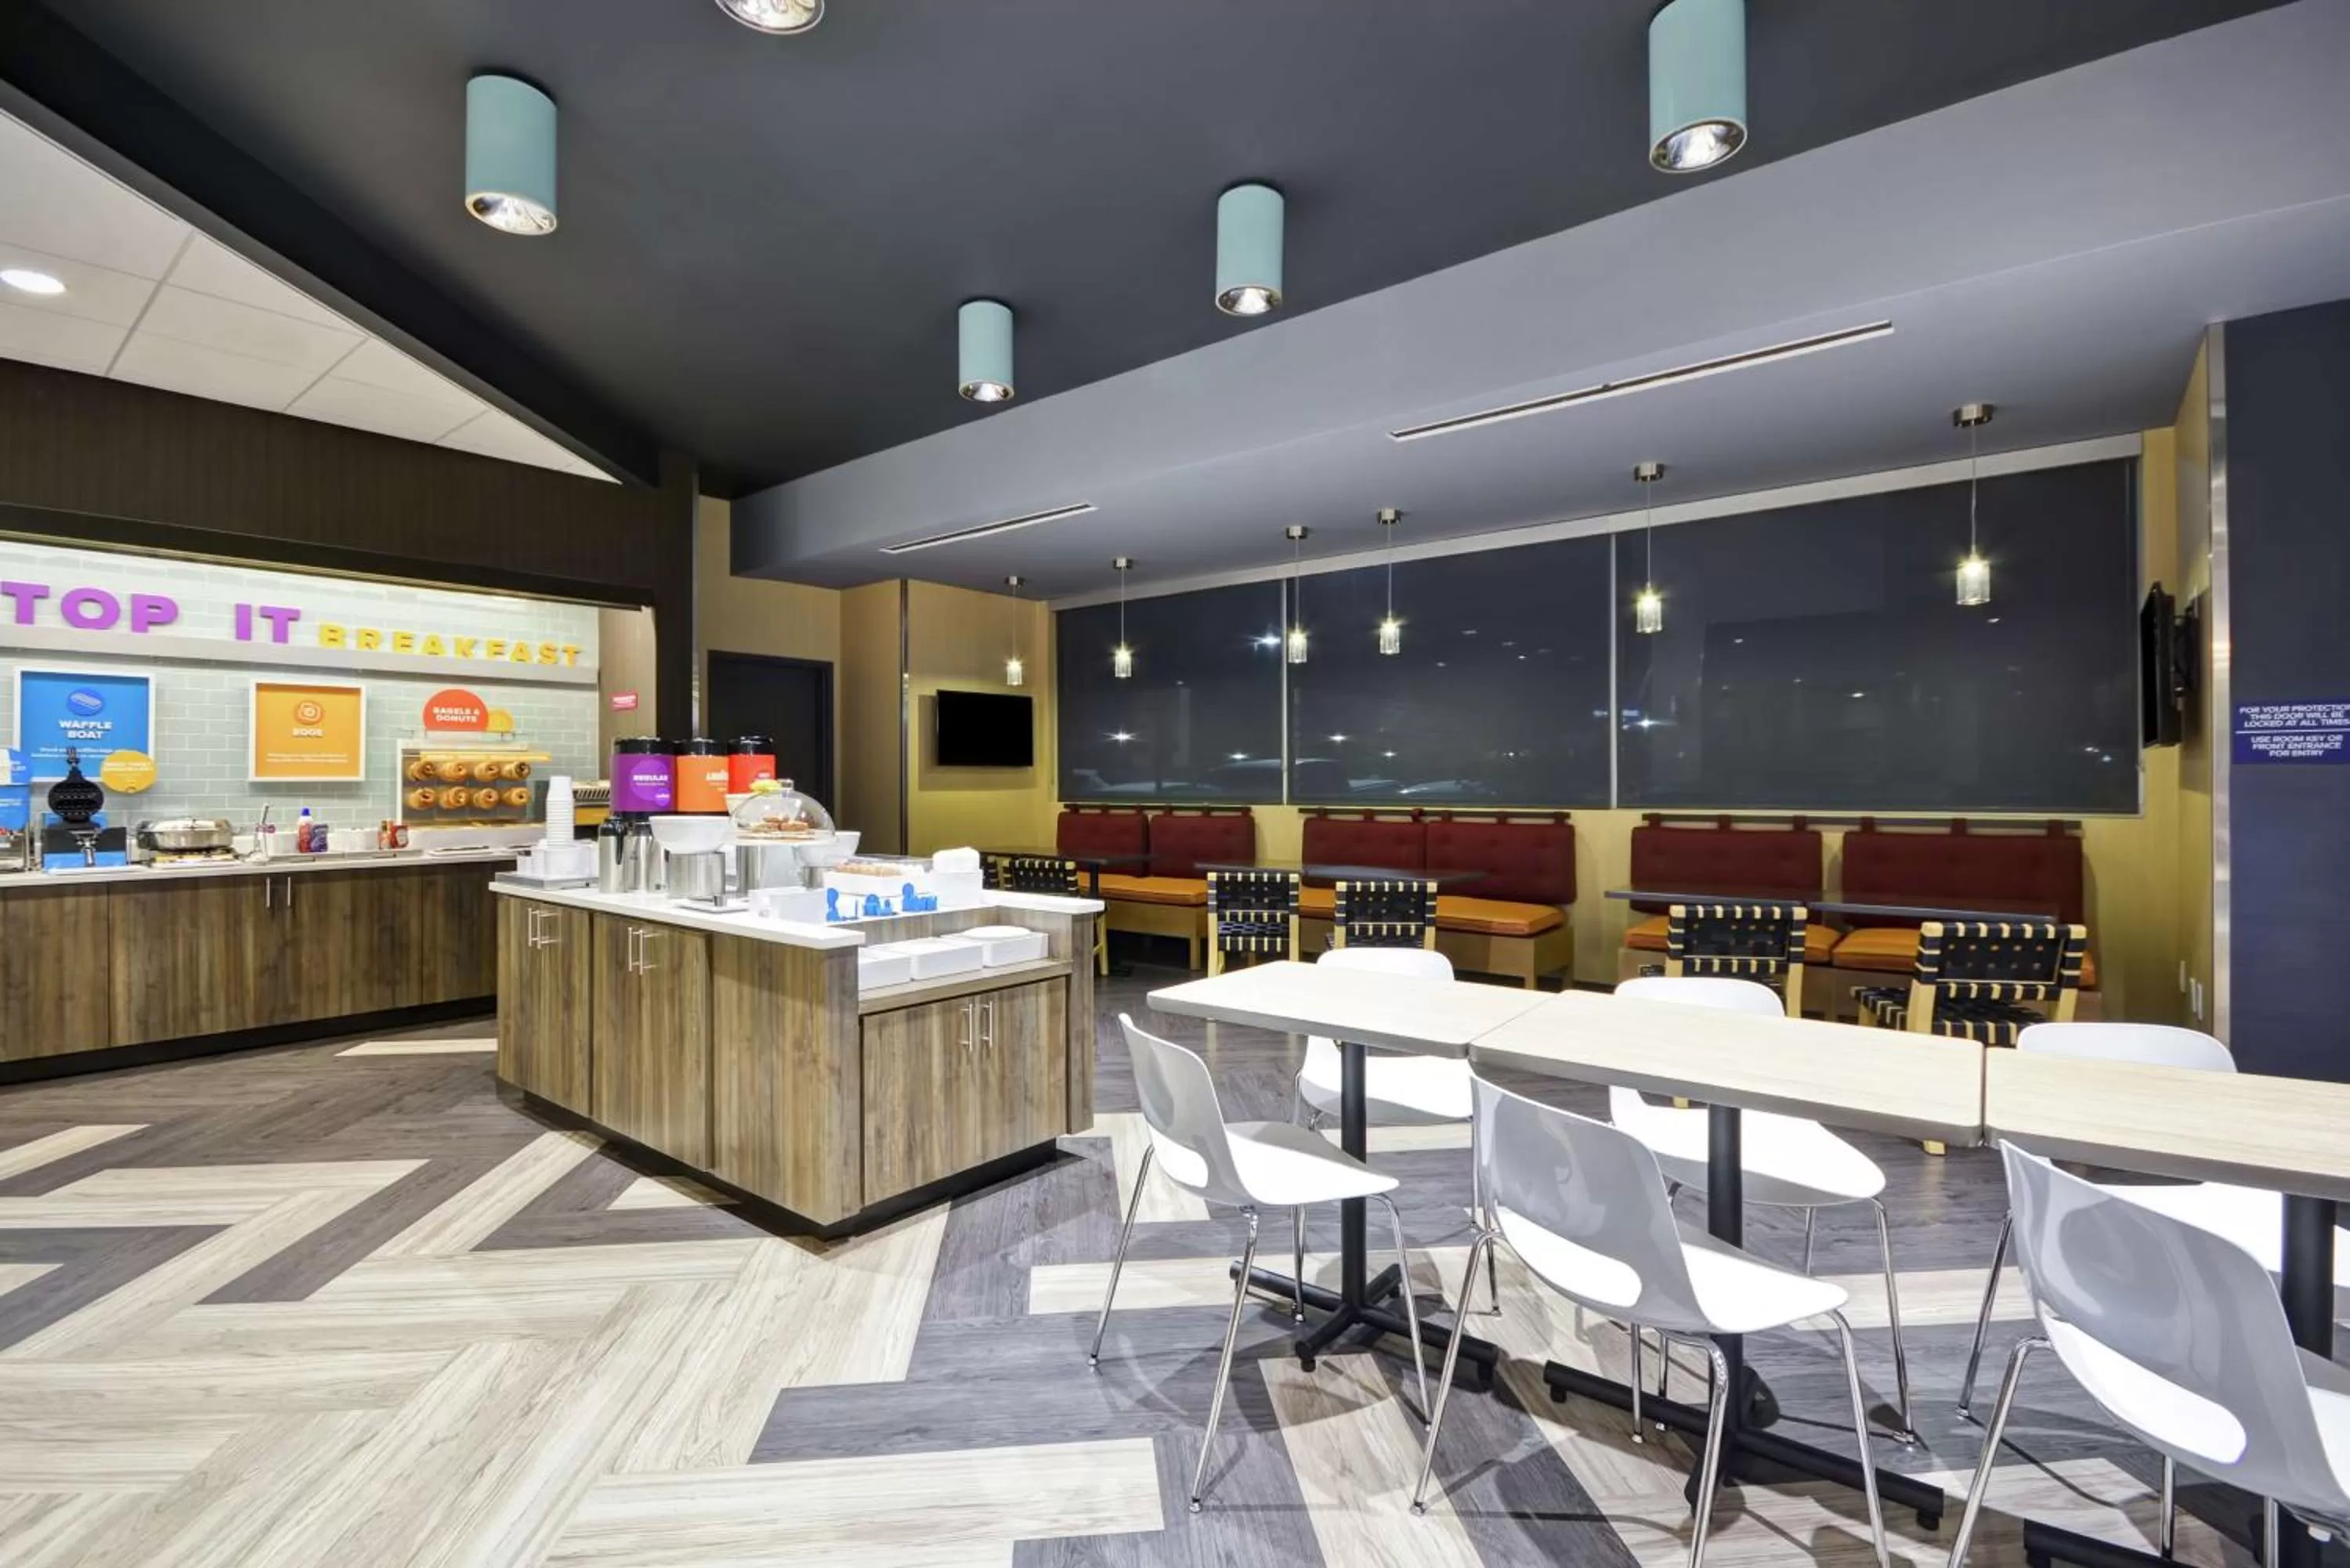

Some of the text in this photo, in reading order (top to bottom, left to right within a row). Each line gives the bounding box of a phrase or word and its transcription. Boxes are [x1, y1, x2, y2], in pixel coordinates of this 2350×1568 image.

[1, 580, 582, 668] TOP IT BREAKFAST
[432, 706, 471, 715] BAGELS
[436, 714, 477, 723] DONUTS
[59, 720, 113, 730] WAFFLE
[67, 730, 104, 739] BOAT
